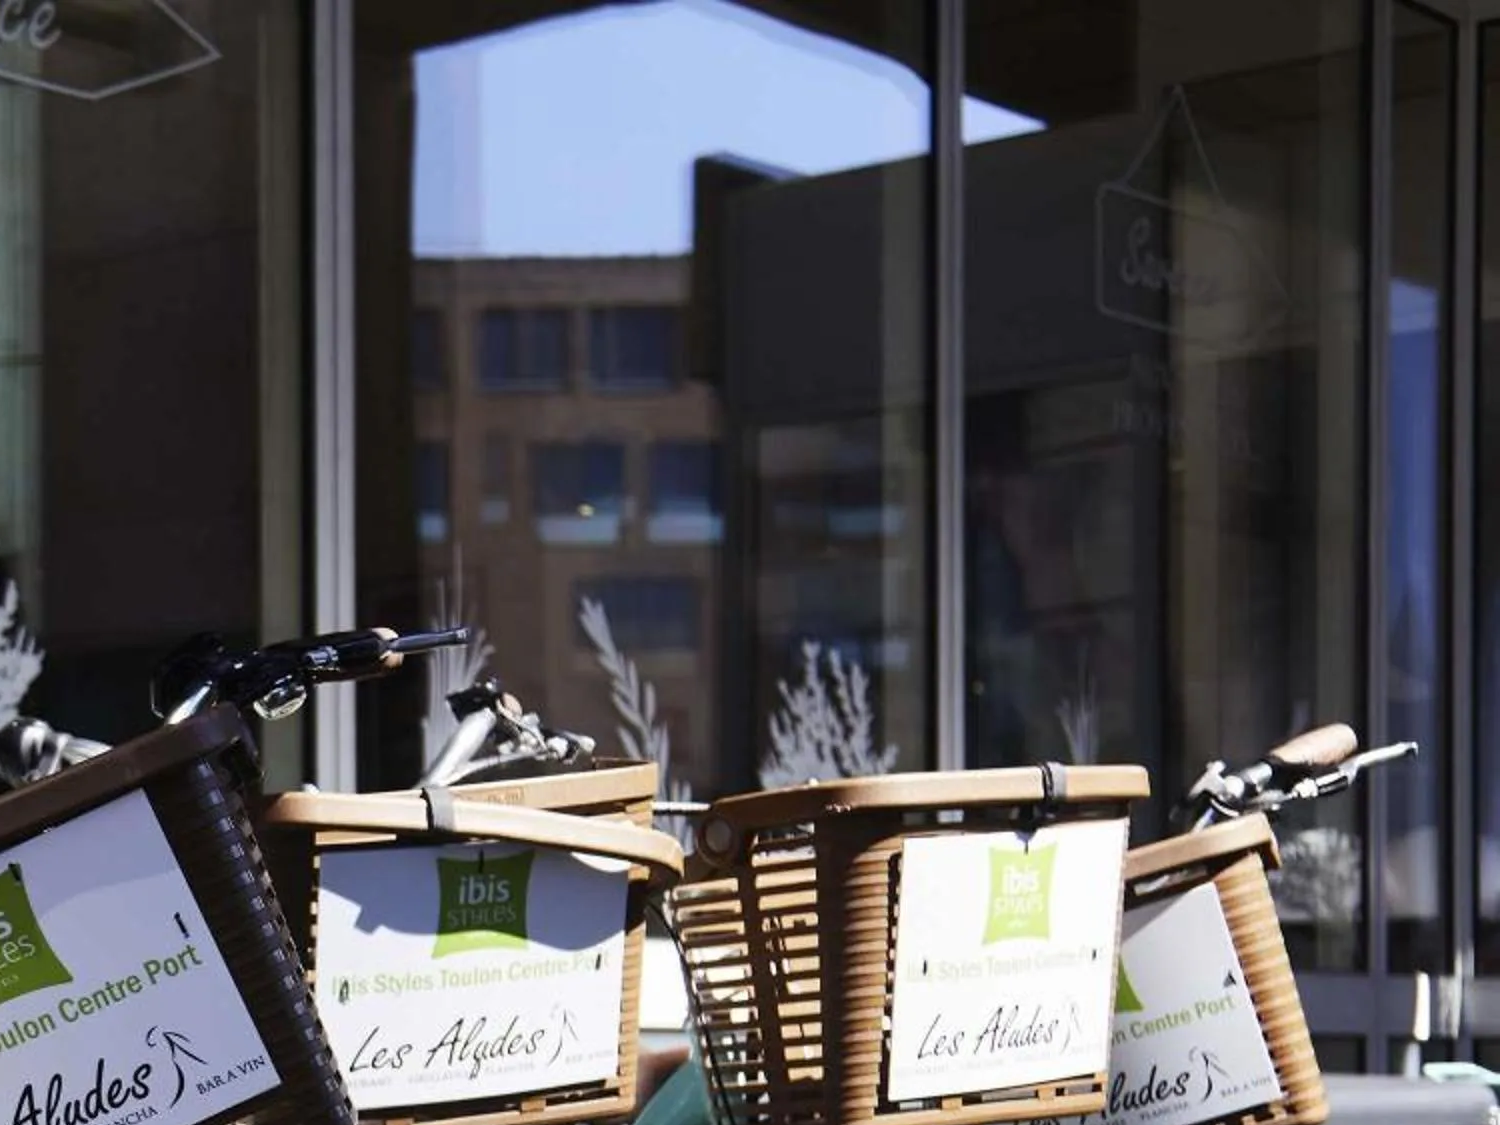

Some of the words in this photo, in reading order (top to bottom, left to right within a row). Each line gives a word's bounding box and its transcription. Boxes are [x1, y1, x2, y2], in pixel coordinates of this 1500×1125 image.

[459, 874, 511, 904] ibis
[1003, 864, 1040, 894] ibis
[59, 975, 143, 1023] Centre
[144, 943, 203, 985] Port
[374, 972, 433, 998] Styles
[440, 966, 502, 988] Toulon
[508, 959, 569, 980] Centre
[917, 1013, 965, 1060] Les
[974, 1004, 1060, 1055] Aludes
[1130, 1010, 1191, 1039] Centre
[1196, 996, 1234, 1018] Port
[349, 1025, 413, 1073] Les
[195, 1075, 226, 1096] BAR
[236, 1055, 266, 1075] VIN
[1079, 1064, 1190, 1124] ludes
